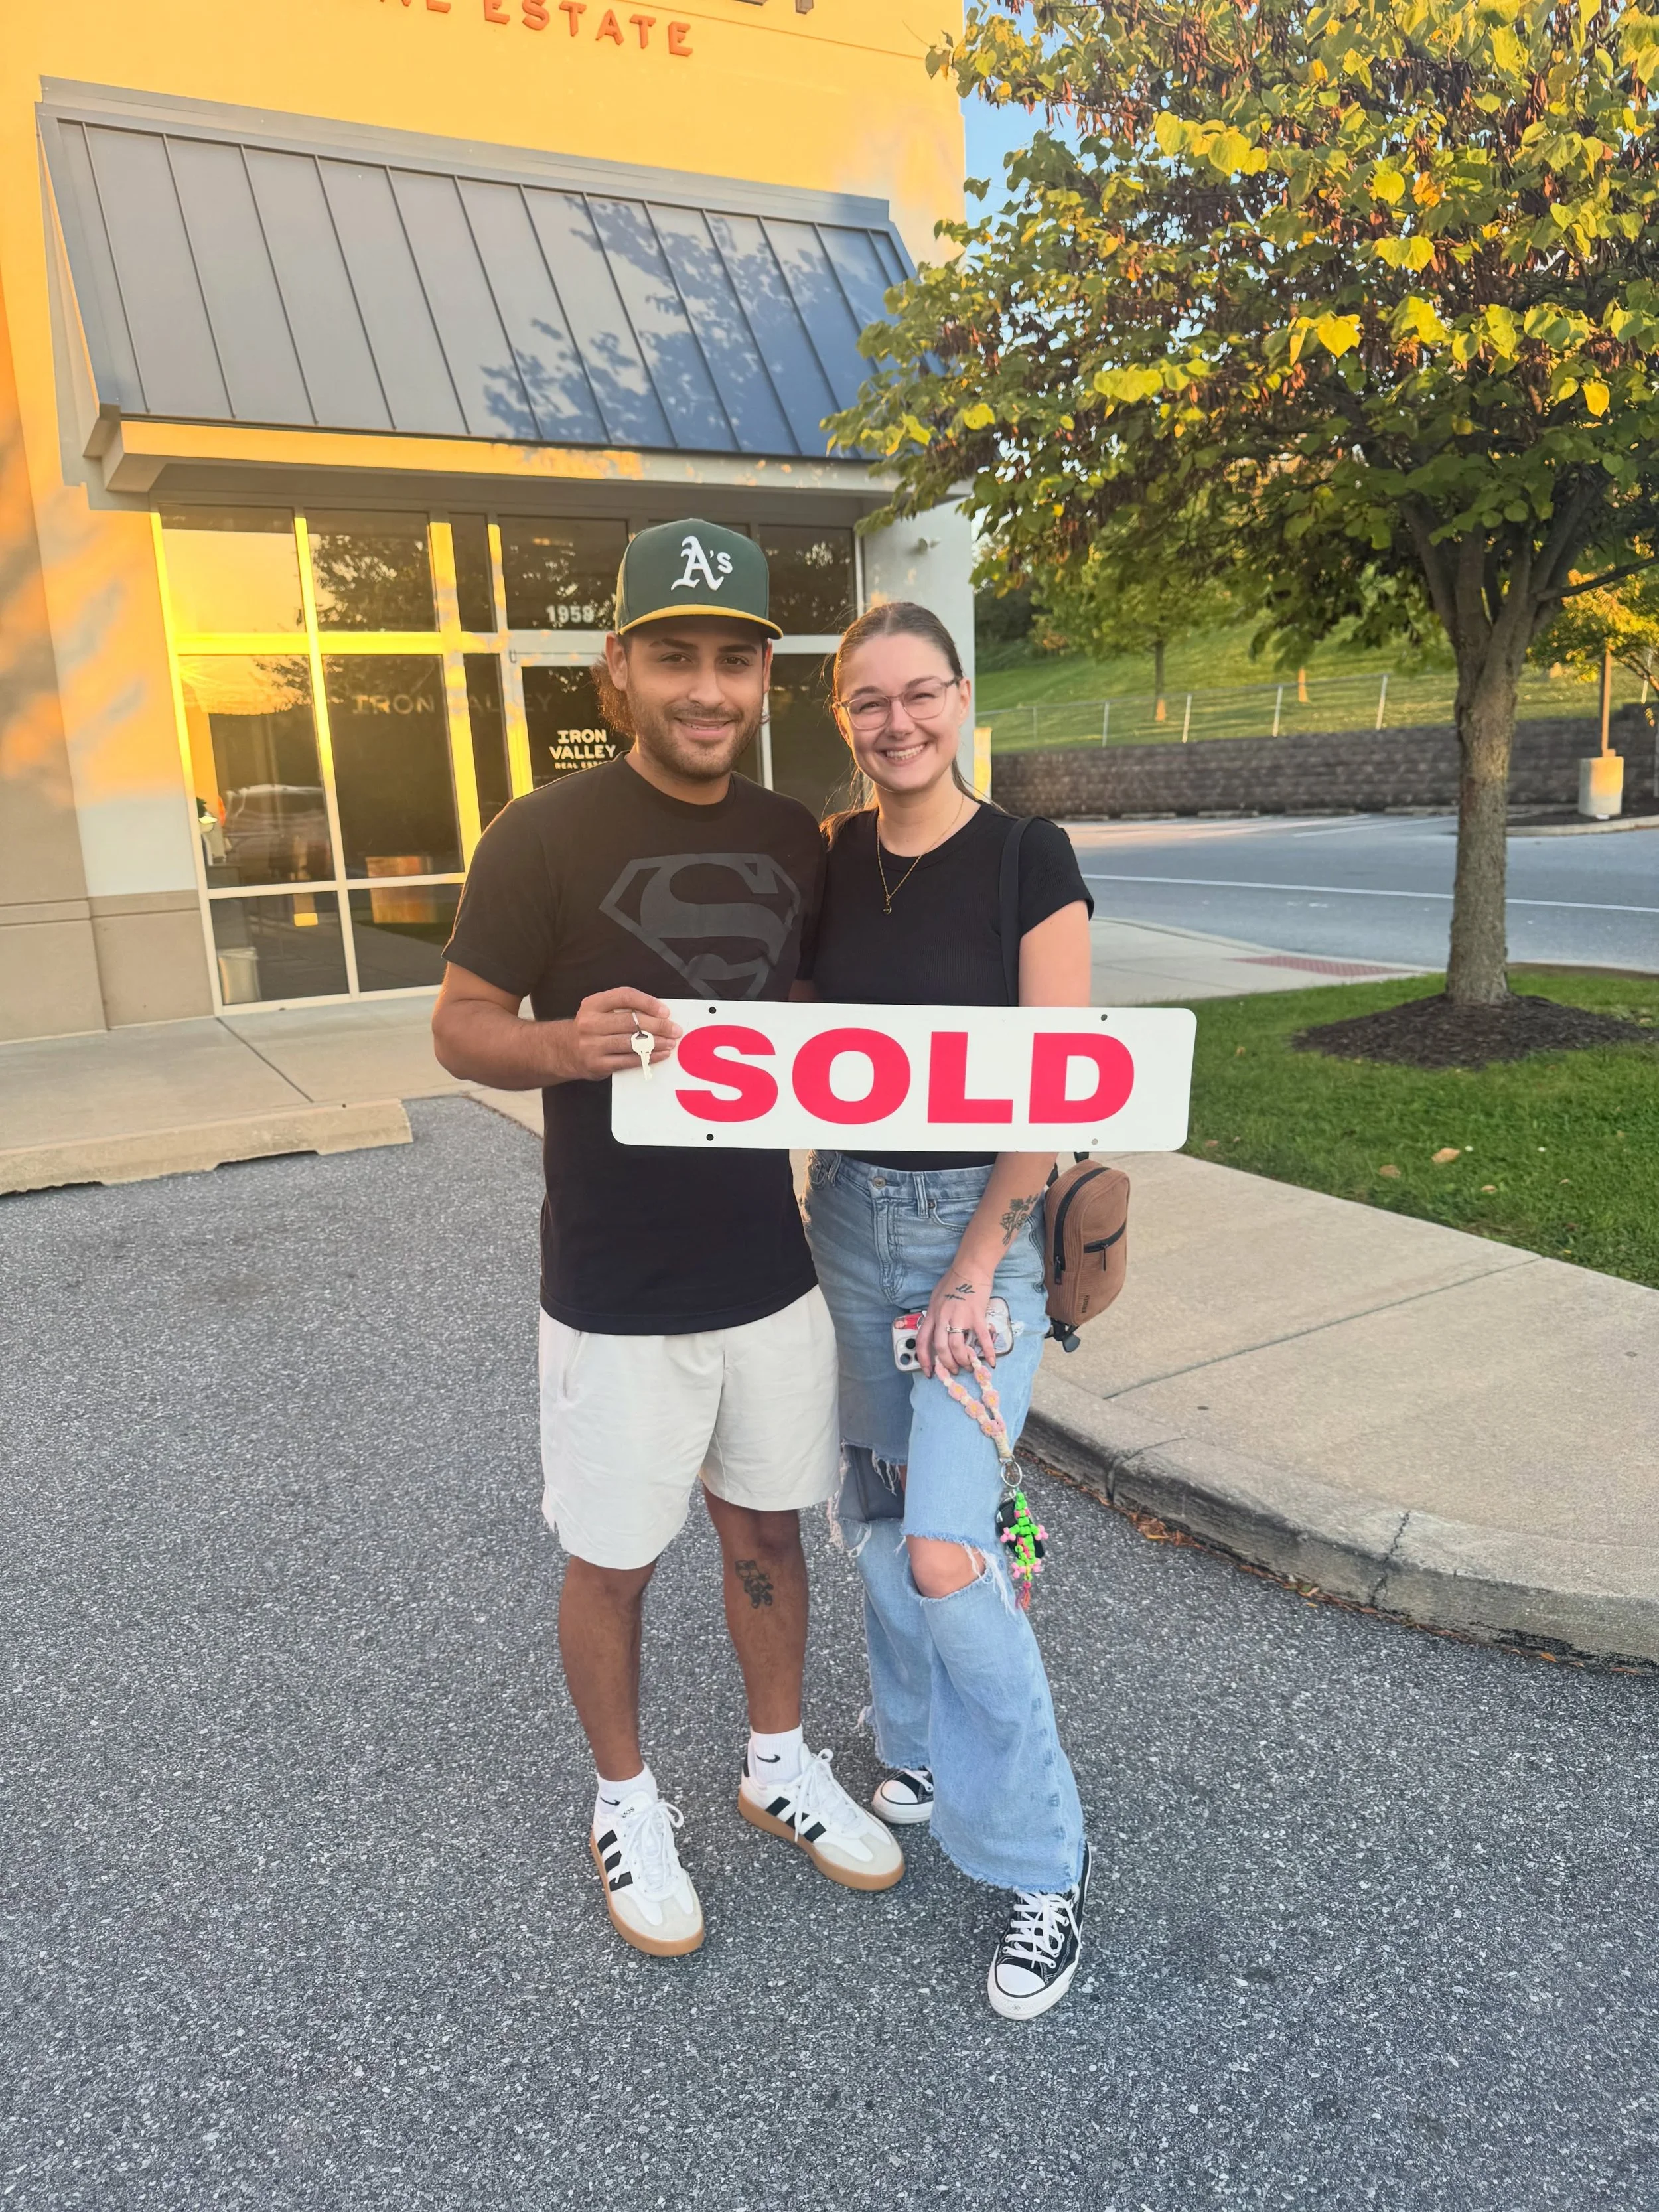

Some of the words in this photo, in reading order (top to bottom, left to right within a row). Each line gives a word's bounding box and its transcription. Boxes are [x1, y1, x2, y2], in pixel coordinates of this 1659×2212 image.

[483, 0, 693, 57] ESTATE
[670, 536, 733, 591] A's
[546, 605, 595, 623] 1958
[352, 694, 435, 715] IRON
[557, 729, 607, 744] IRON
[549, 744, 616, 760] VALLEY
[675, 1025, 1135, 1125] SOLD
